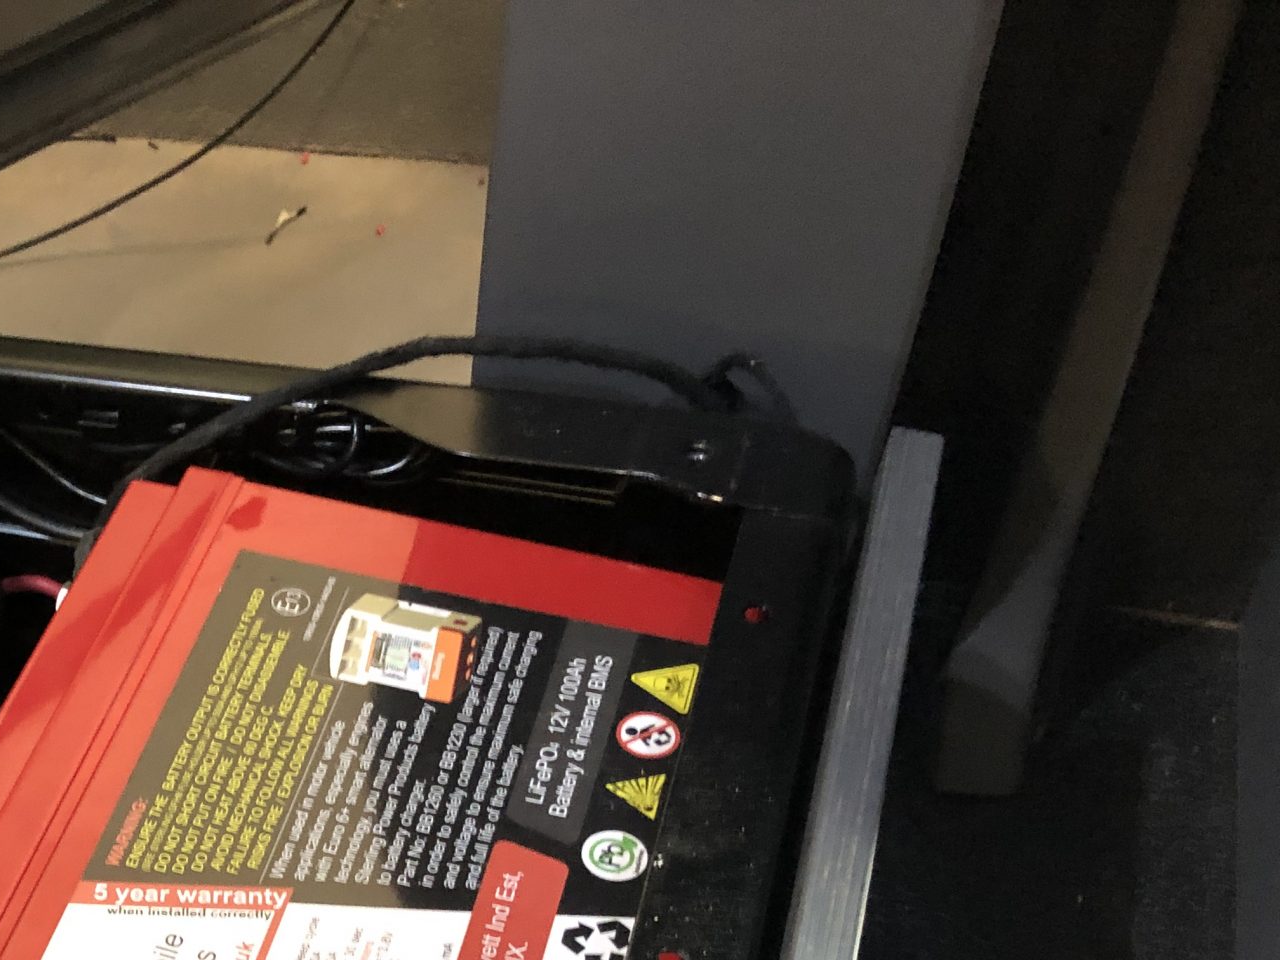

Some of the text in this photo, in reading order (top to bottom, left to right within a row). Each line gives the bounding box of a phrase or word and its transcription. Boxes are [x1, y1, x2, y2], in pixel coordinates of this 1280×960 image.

[556, 656, 588, 703] 100Ah
[546, 703, 573, 735] 12V
[547, 653, 615, 819] Battery & internal BMS
[354, 714, 389, 771] alternator
[268, 719, 347, 879] When used in motor vehicle
[341, 769, 367, 805] smart
[353, 701, 438, 885] Sterling Power Products battery
[321, 823, 346, 855] Euro
[380, 825, 412, 871] battery
[310, 854, 334, 883] with
[374, 870, 395, 886] to
[94, 882, 287, 909] 5 year warranty
[107, 905, 271, 921] when installed correctly
[484, 903, 511, 933] Ind
